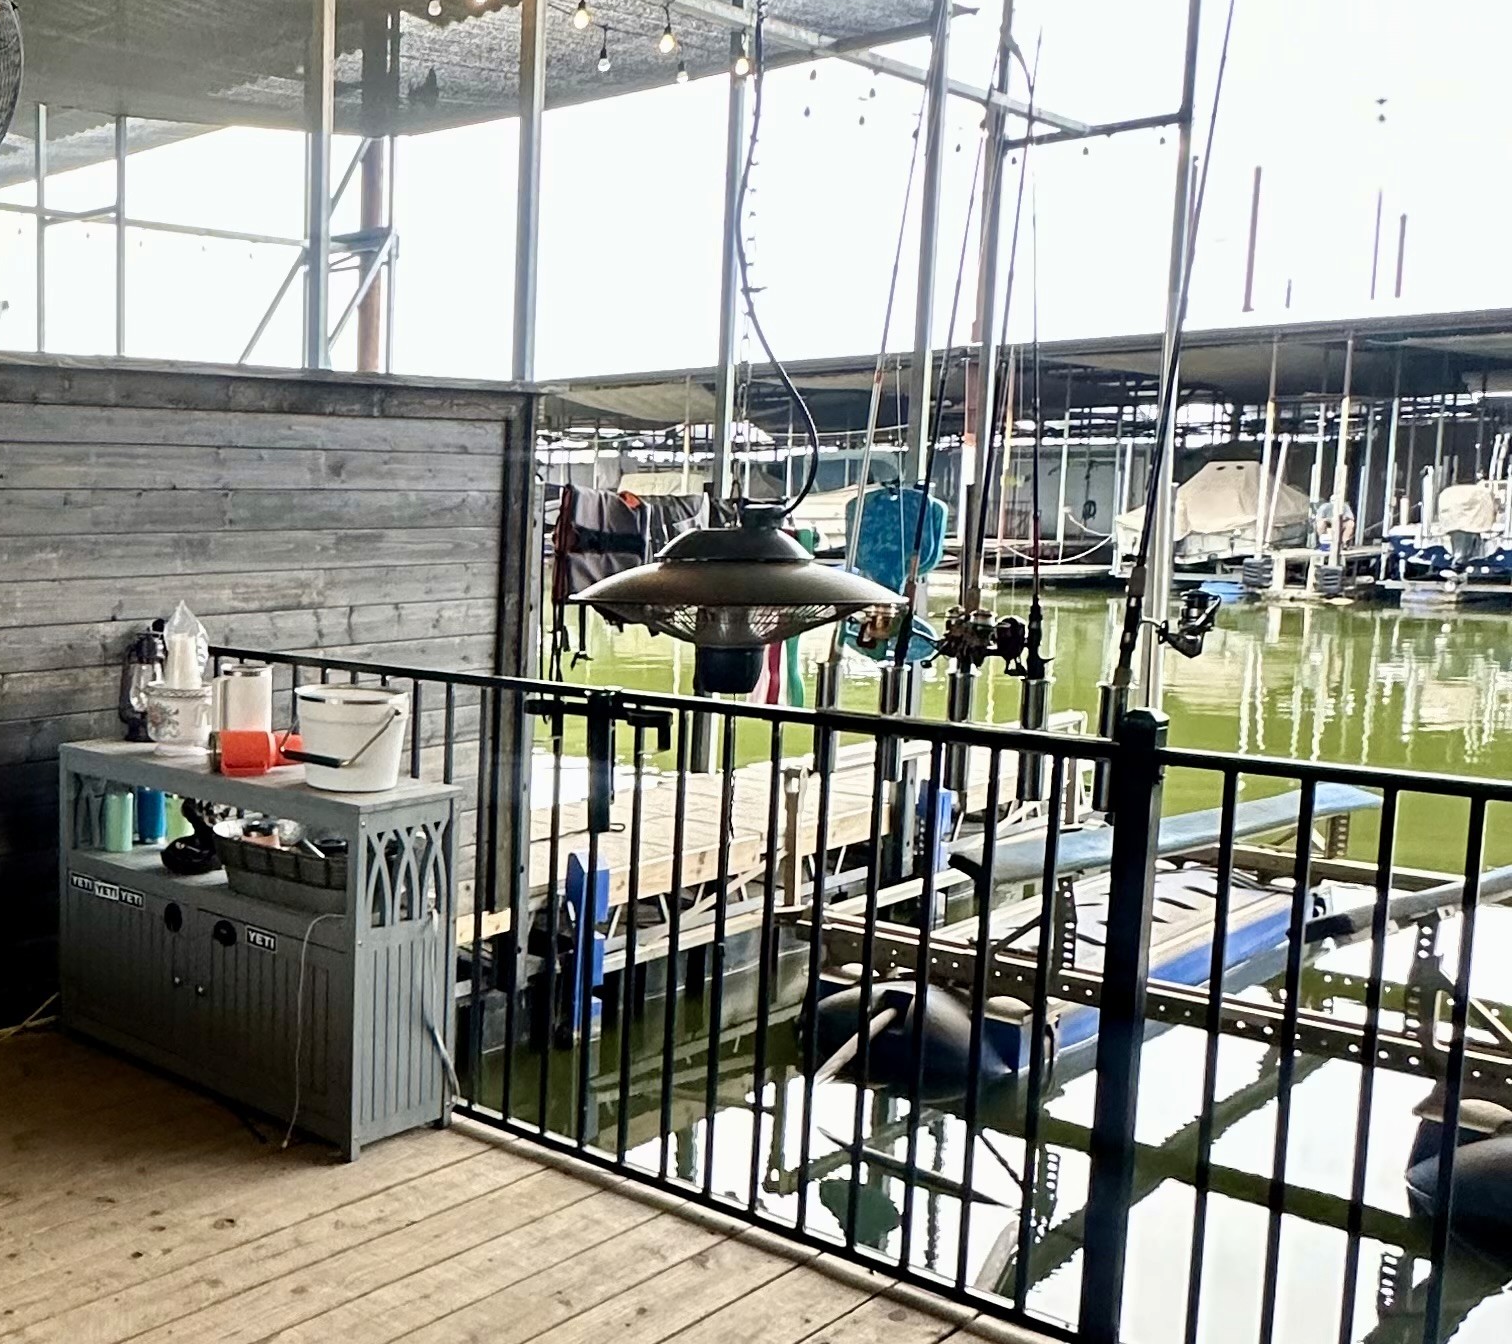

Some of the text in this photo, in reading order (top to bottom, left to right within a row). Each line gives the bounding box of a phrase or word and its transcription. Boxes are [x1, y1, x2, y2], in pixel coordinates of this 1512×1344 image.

[71, 875, 143, 906] YETI YETI YETI
[247, 930, 275, 949] YETI
